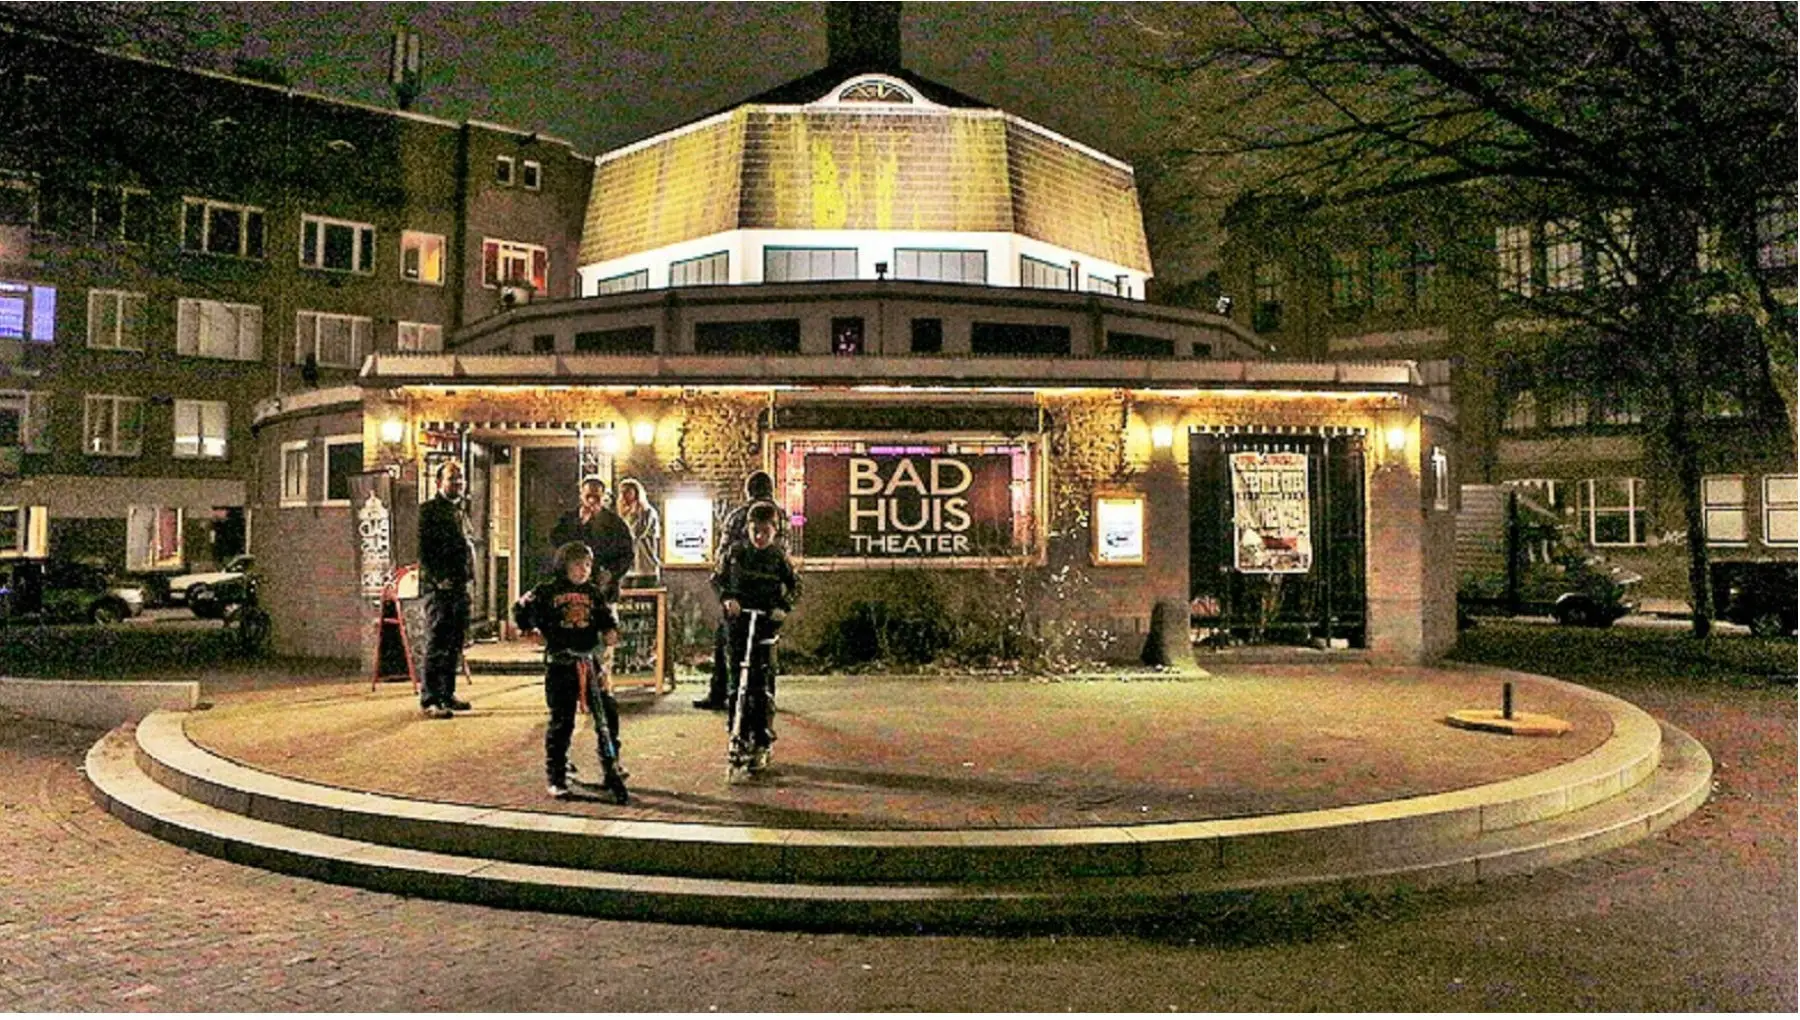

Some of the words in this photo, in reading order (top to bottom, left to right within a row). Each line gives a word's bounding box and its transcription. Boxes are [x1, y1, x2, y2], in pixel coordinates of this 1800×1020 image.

[850, 458, 972, 495] BAD
[850, 498, 971, 532] HUIS
[850, 534, 970, 553] THEATER
